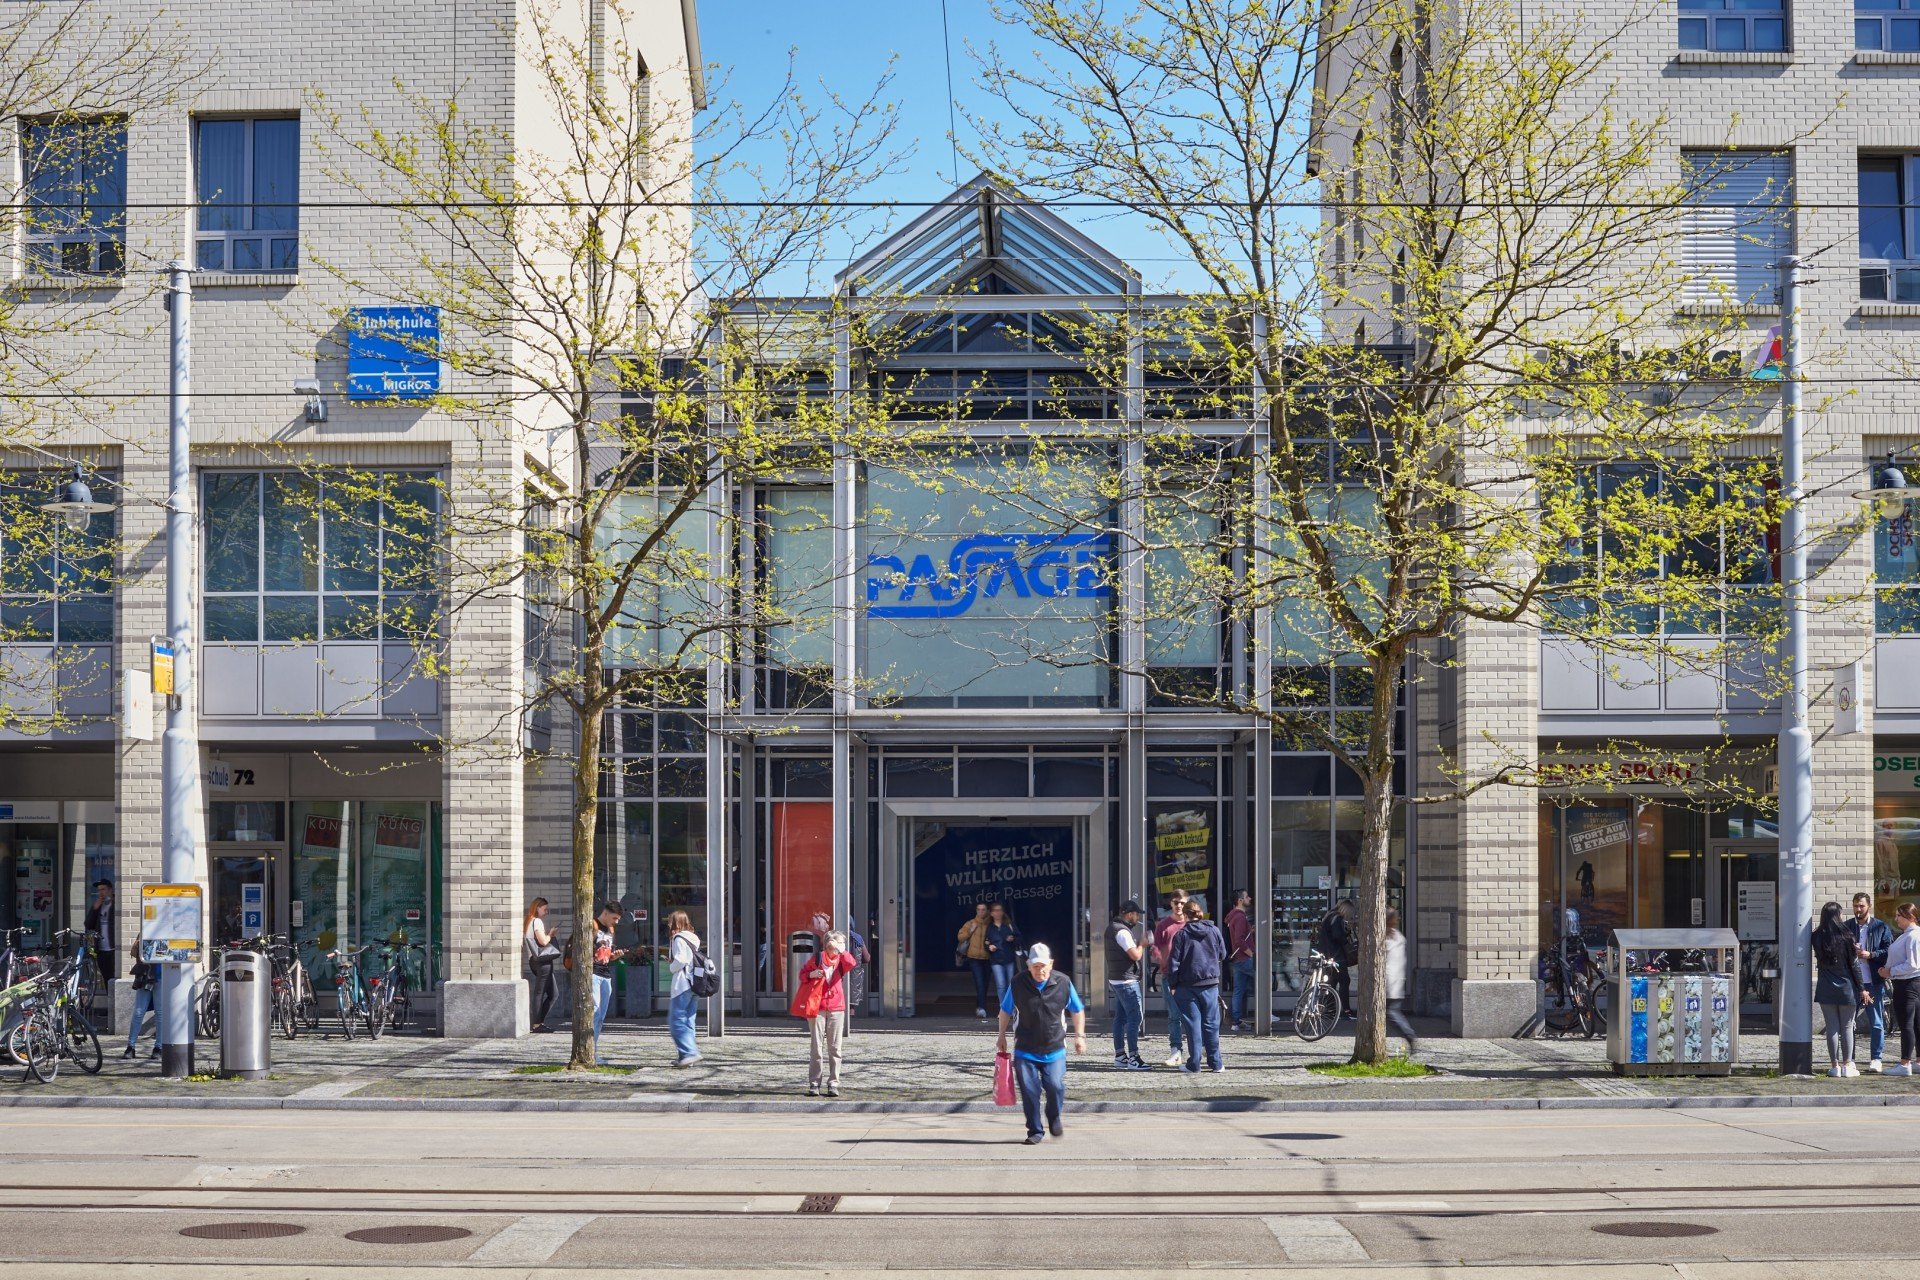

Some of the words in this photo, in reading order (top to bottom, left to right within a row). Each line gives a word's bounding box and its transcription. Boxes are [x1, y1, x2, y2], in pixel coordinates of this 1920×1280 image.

[357, 315, 432, 329] lubchule
[384, 380, 431, 391] MIGROS
[1619, 763, 1698, 781] SPORT
[1873, 757, 1920, 771] OSE
[233, 770, 255, 786] 72
[379, 818, 421, 833] KÜNG
[1572, 829, 1604, 844] SPORT
[1606, 823, 1624, 834] AUF
[1574, 843, 1583, 852] 2
[1583, 831, 1627, 850] ETAGEN
[965, 842, 1054, 866] HERZLICH
[945, 859, 1073, 887] WILLKOMMEN
[957, 891, 972, 906] in
[975, 888, 1001, 905] der
[1004, 883, 1063, 902] Passage
